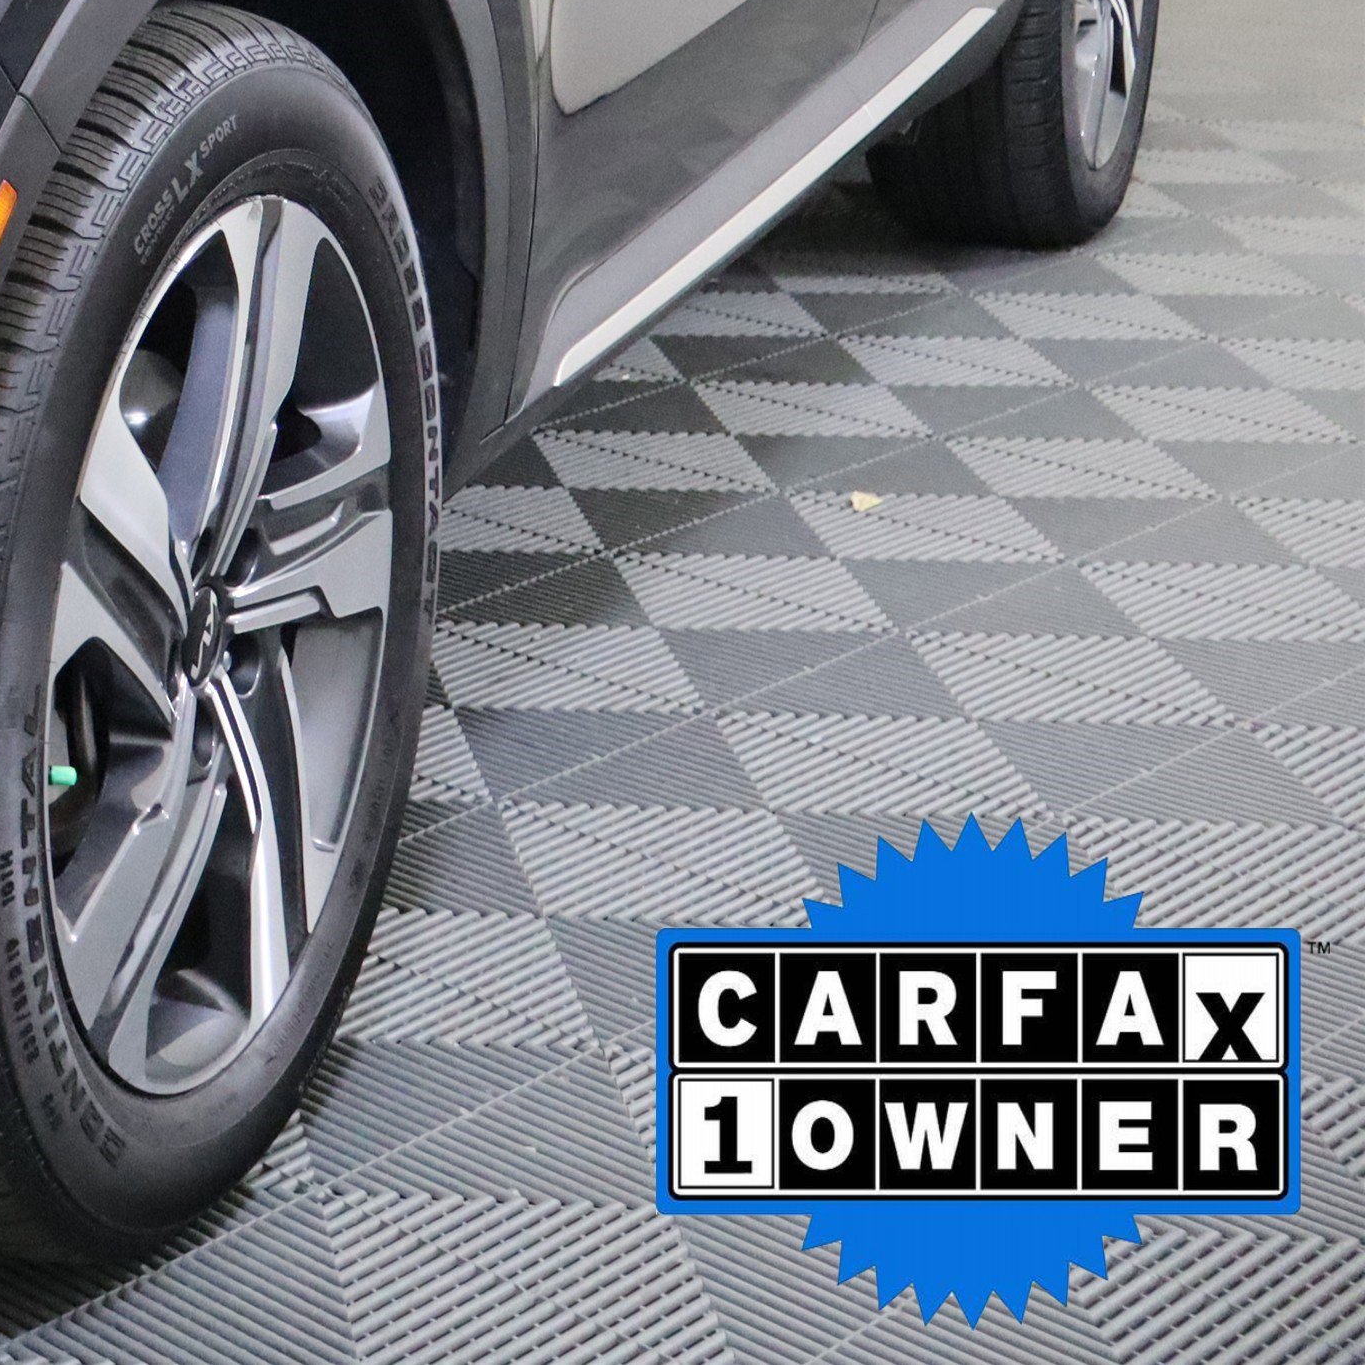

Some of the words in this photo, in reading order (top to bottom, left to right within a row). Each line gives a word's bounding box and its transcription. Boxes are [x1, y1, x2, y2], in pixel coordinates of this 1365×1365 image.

[134, 189, 173, 255] CROSS
[171, 150, 204, 204] LX
[200, 115, 237, 158] SPORT
